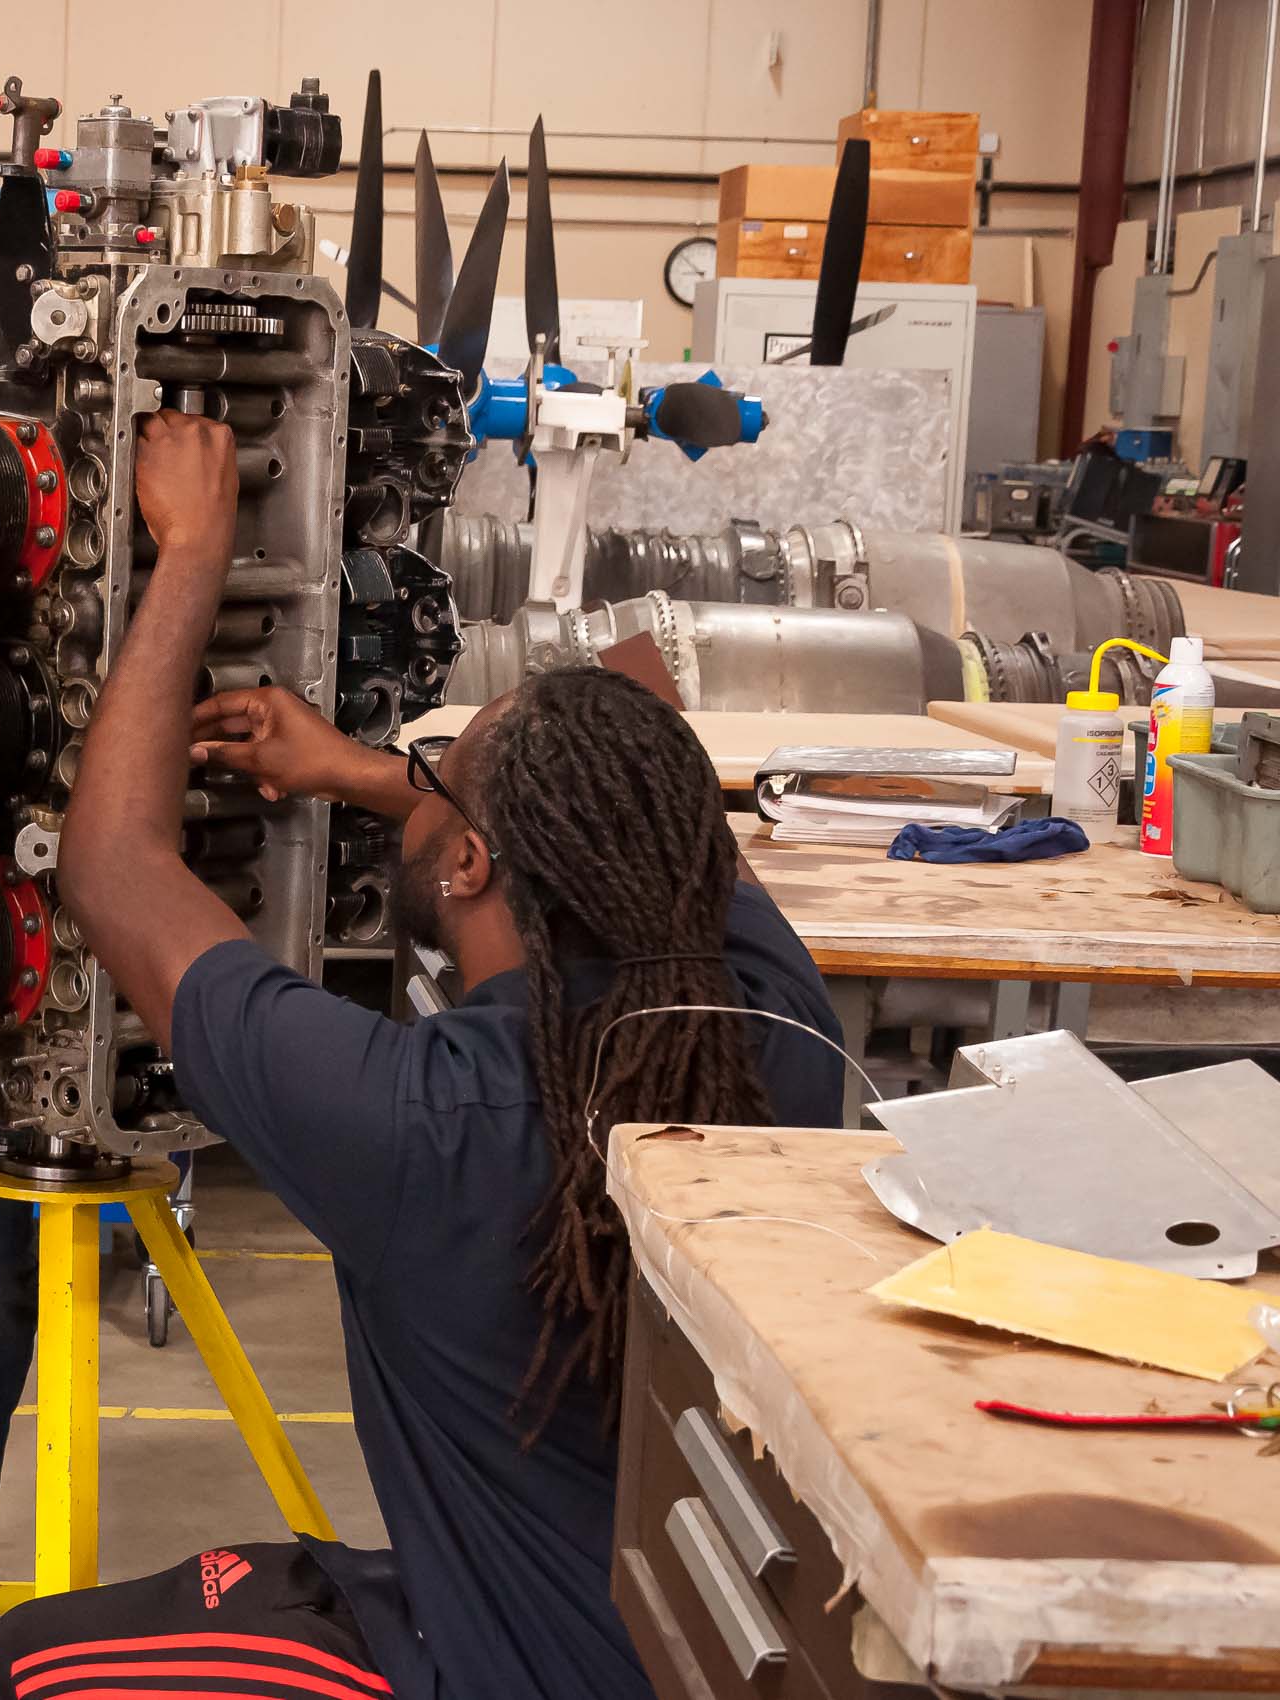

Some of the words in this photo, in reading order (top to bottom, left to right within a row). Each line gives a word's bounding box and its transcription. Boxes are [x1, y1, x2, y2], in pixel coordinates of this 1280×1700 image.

[1107, 764, 1115, 776] 3
[1096, 776, 1102, 789] 1
[200, 1551, 220, 1609] didas
